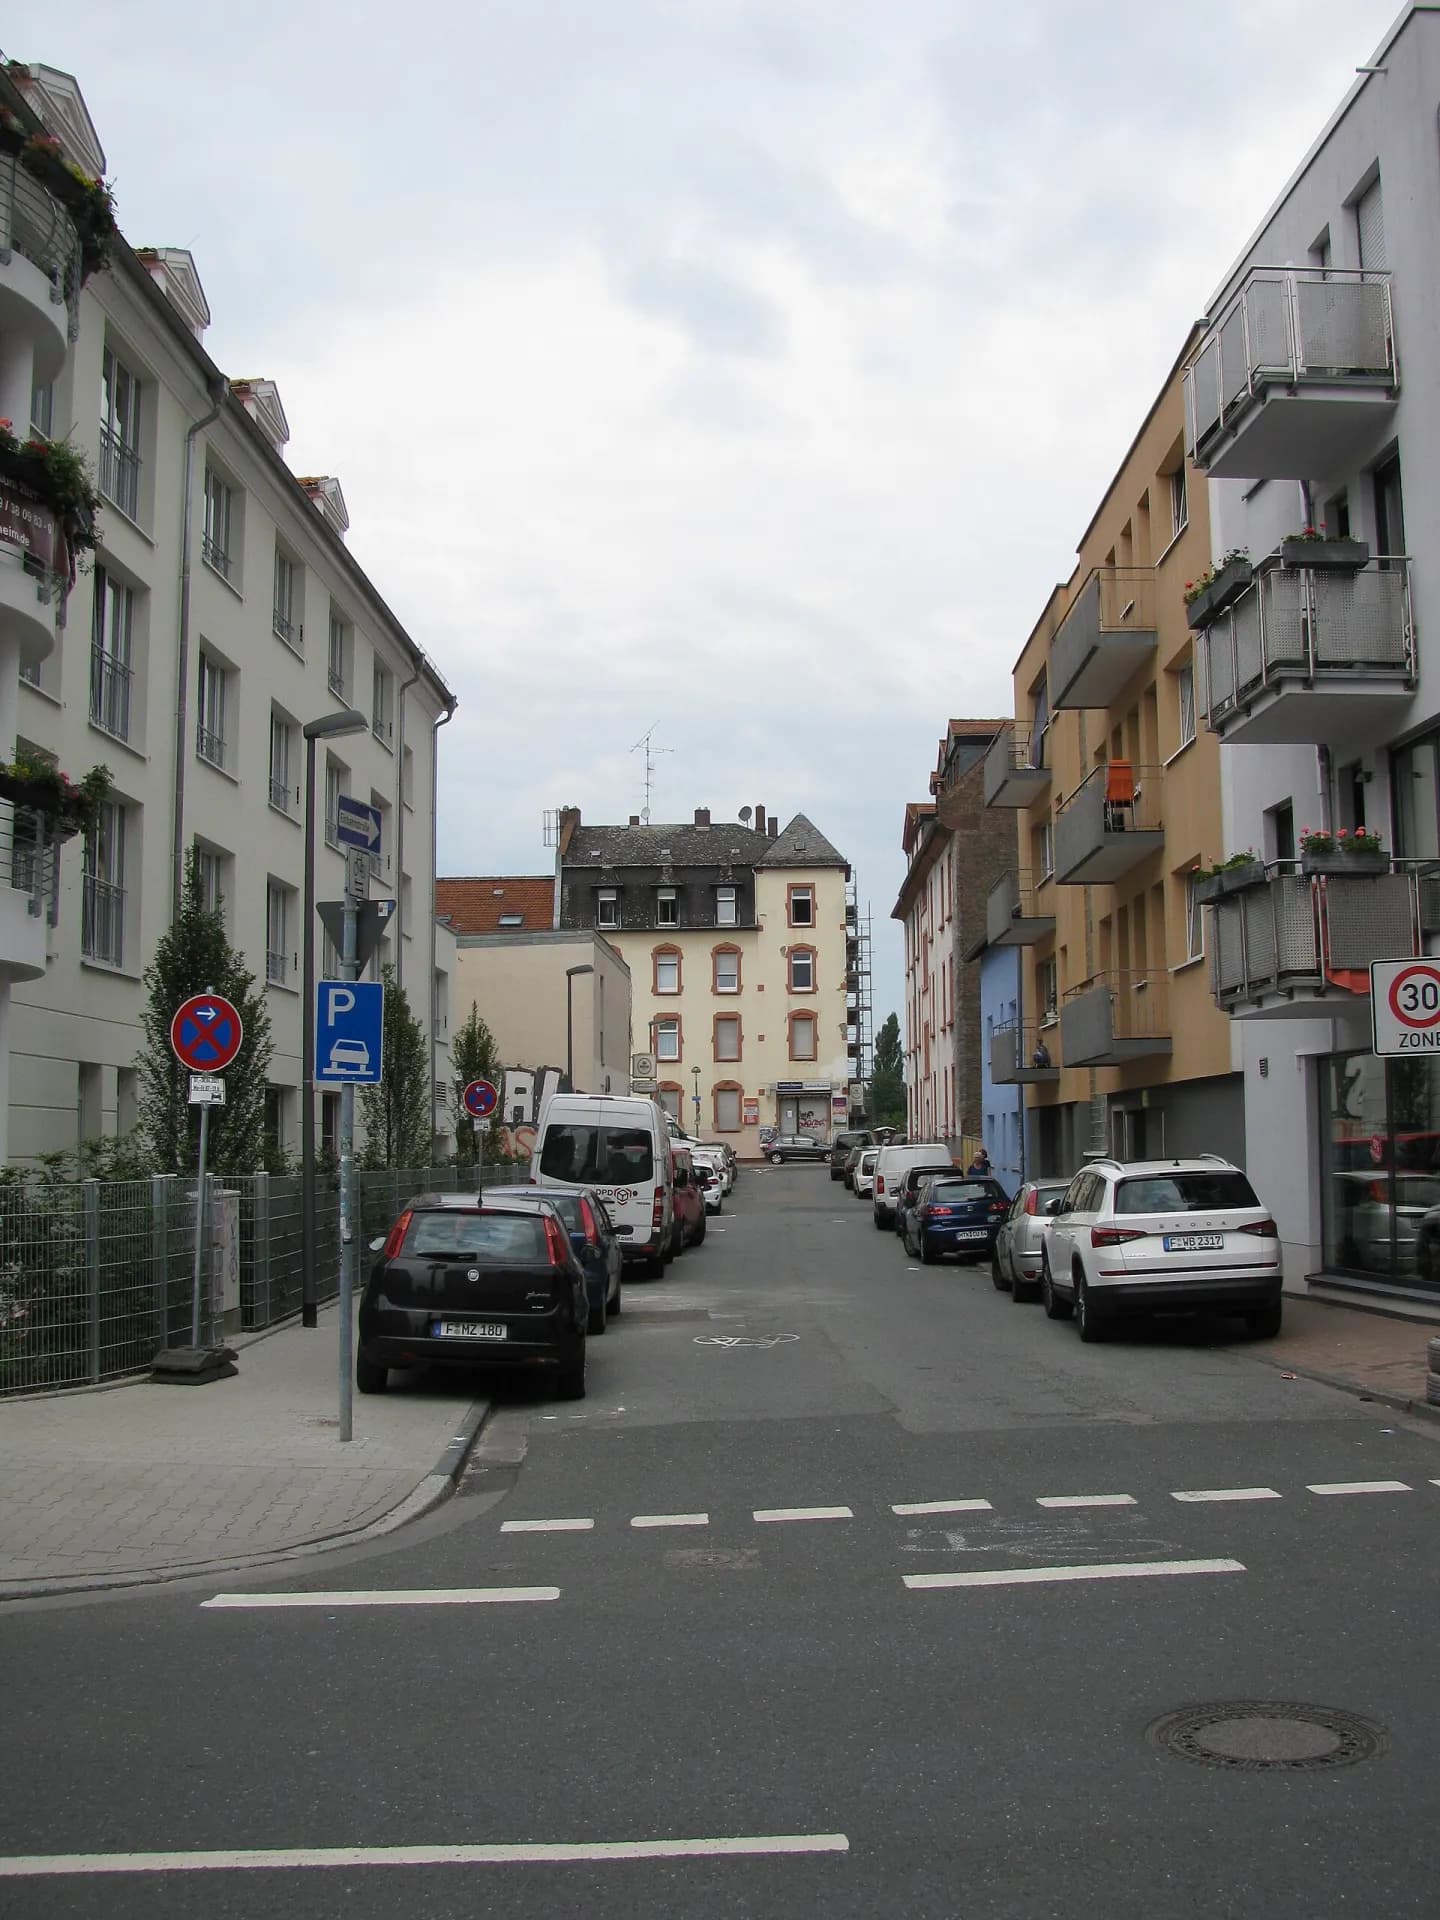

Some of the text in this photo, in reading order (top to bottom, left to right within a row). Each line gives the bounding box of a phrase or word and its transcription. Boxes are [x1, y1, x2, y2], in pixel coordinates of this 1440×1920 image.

[1402, 982, 1438, 1011] 30
[328, 988, 355, 1026] P
[1170, 1236, 1221, 1247] F WB 2317
[446, 1324, 503, 1336] F MZ 180
